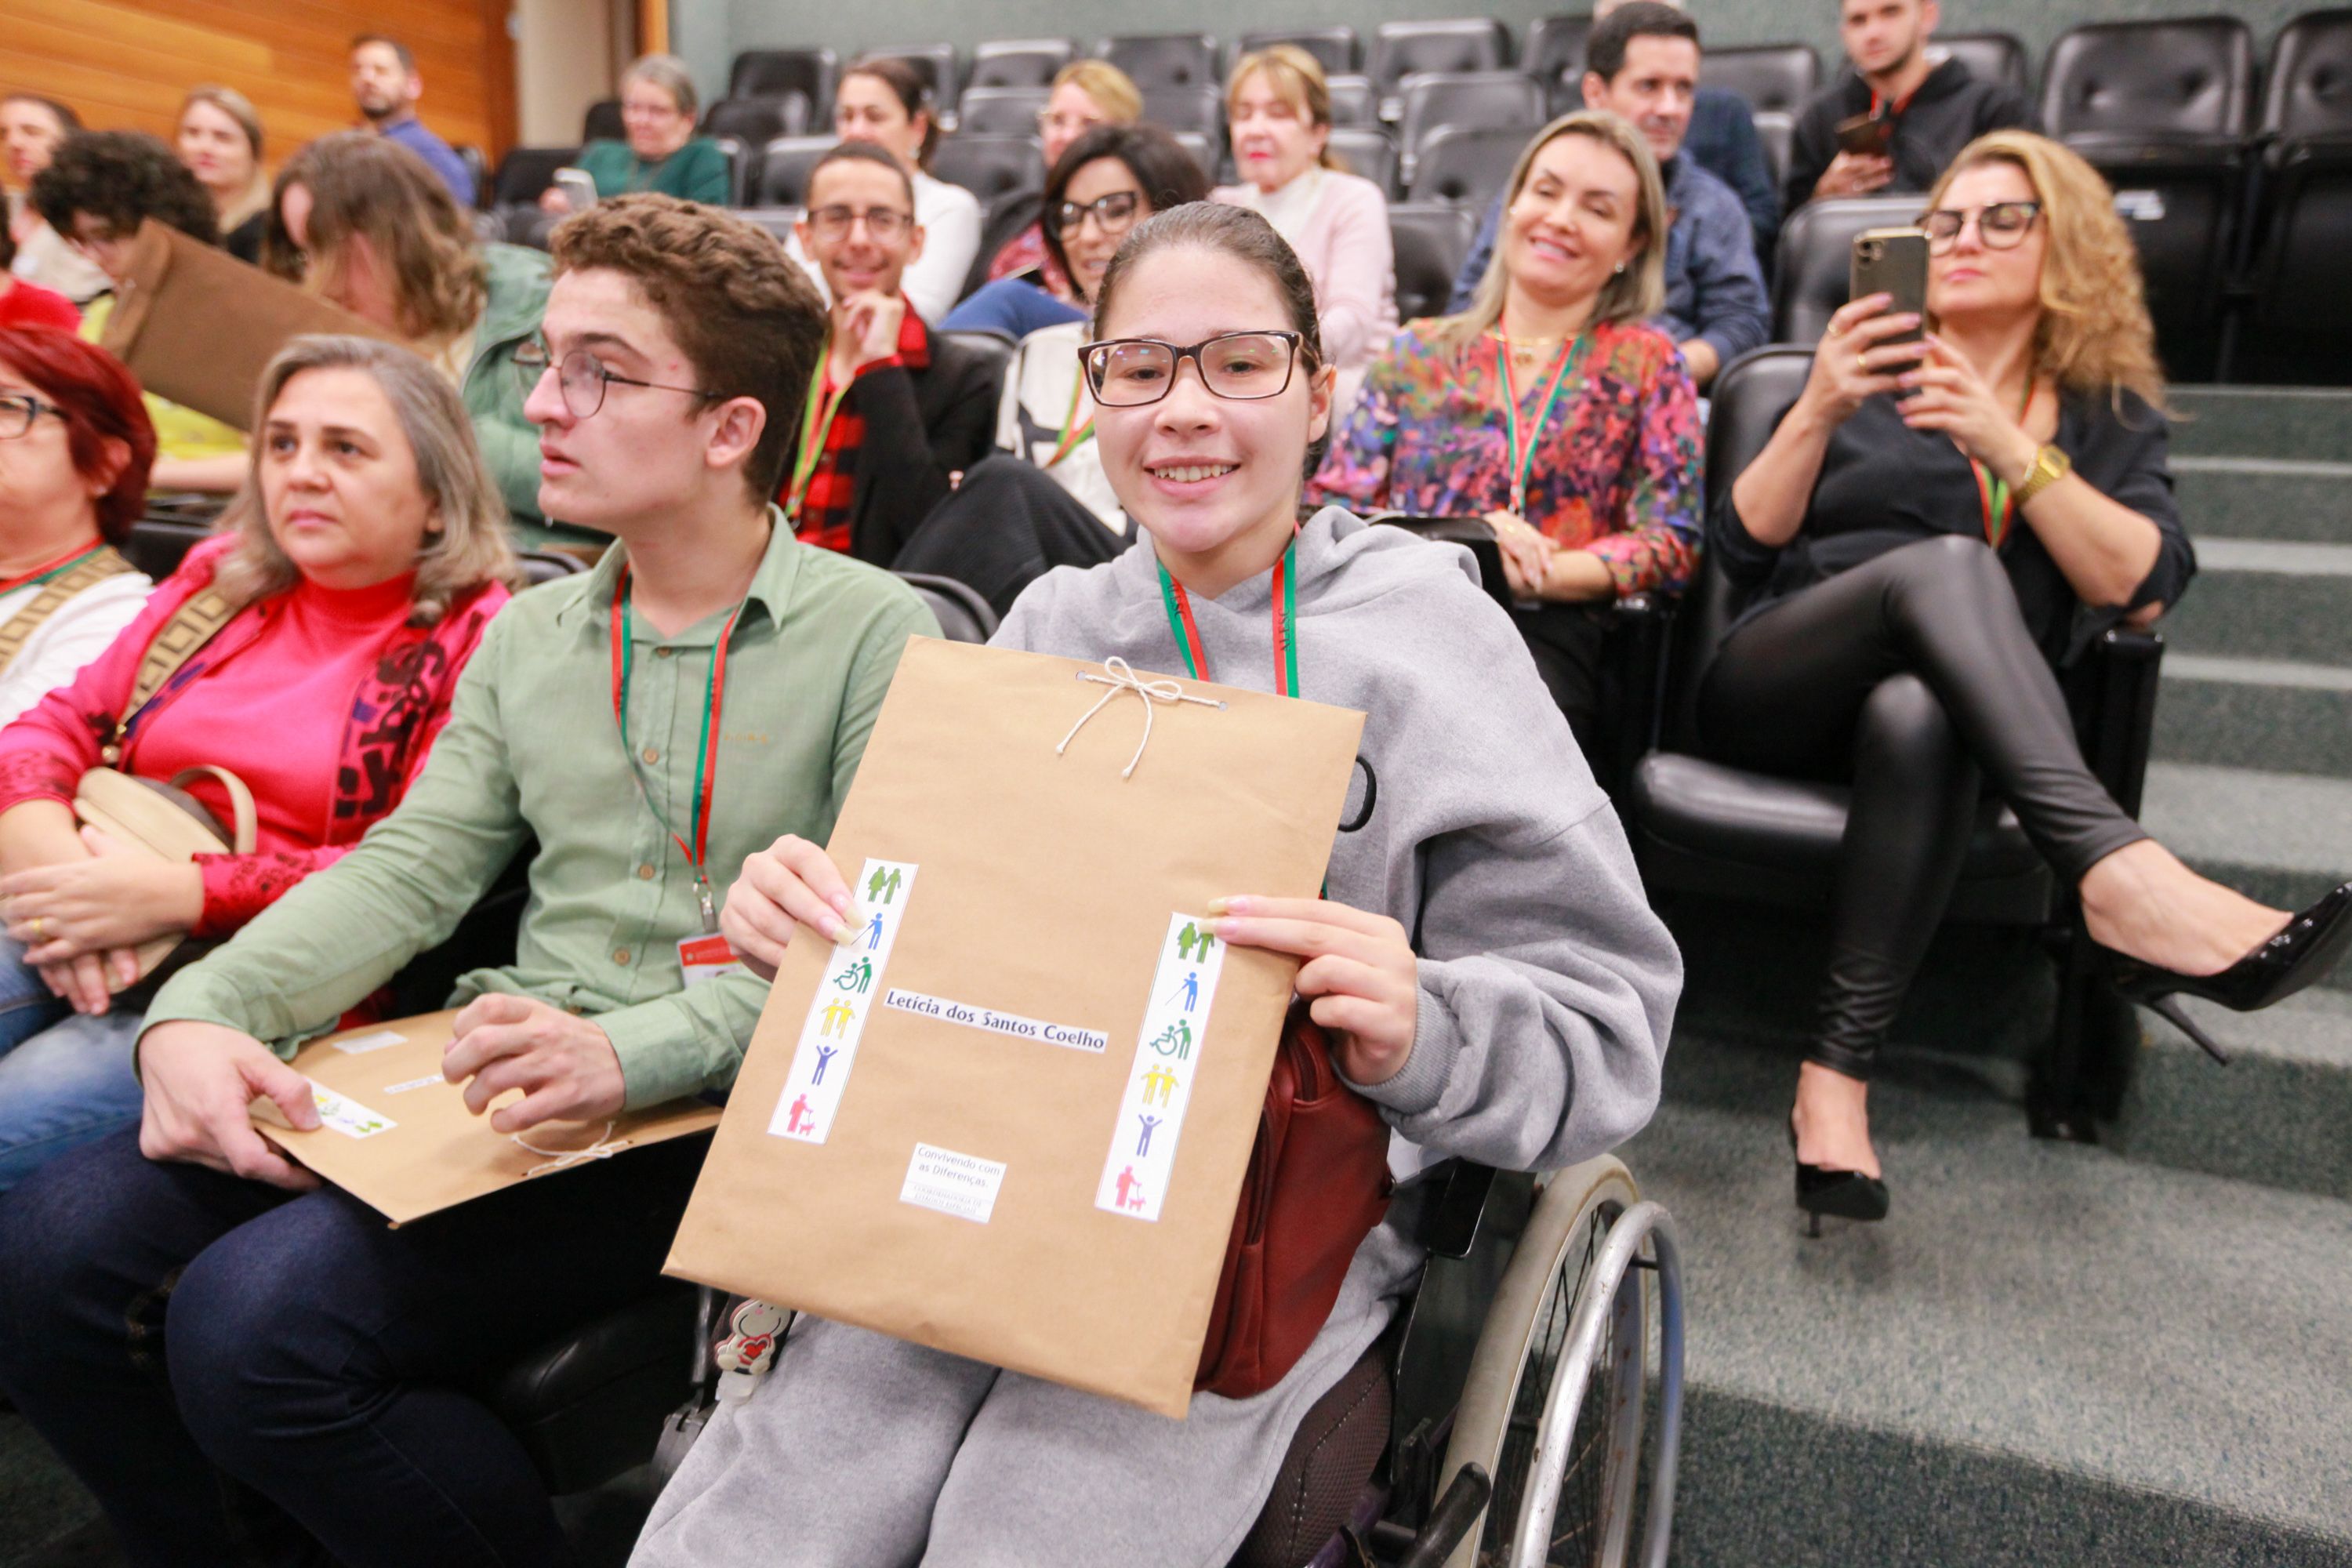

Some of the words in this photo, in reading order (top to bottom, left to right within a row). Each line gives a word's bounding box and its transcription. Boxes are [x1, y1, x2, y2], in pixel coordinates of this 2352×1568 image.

[1278, 608, 1290, 652] ALESC
[886, 990, 940, 1015] Letícia
[946, 1004, 975, 1023] dos
[981, 1011, 1036, 1036] Santos
[1044, 1025, 1105, 1050] Coelho
[917, 1146, 976, 1170] Convivendo
[978, 1164, 1000, 1176] com
[919, 1163, 930, 1173] as
